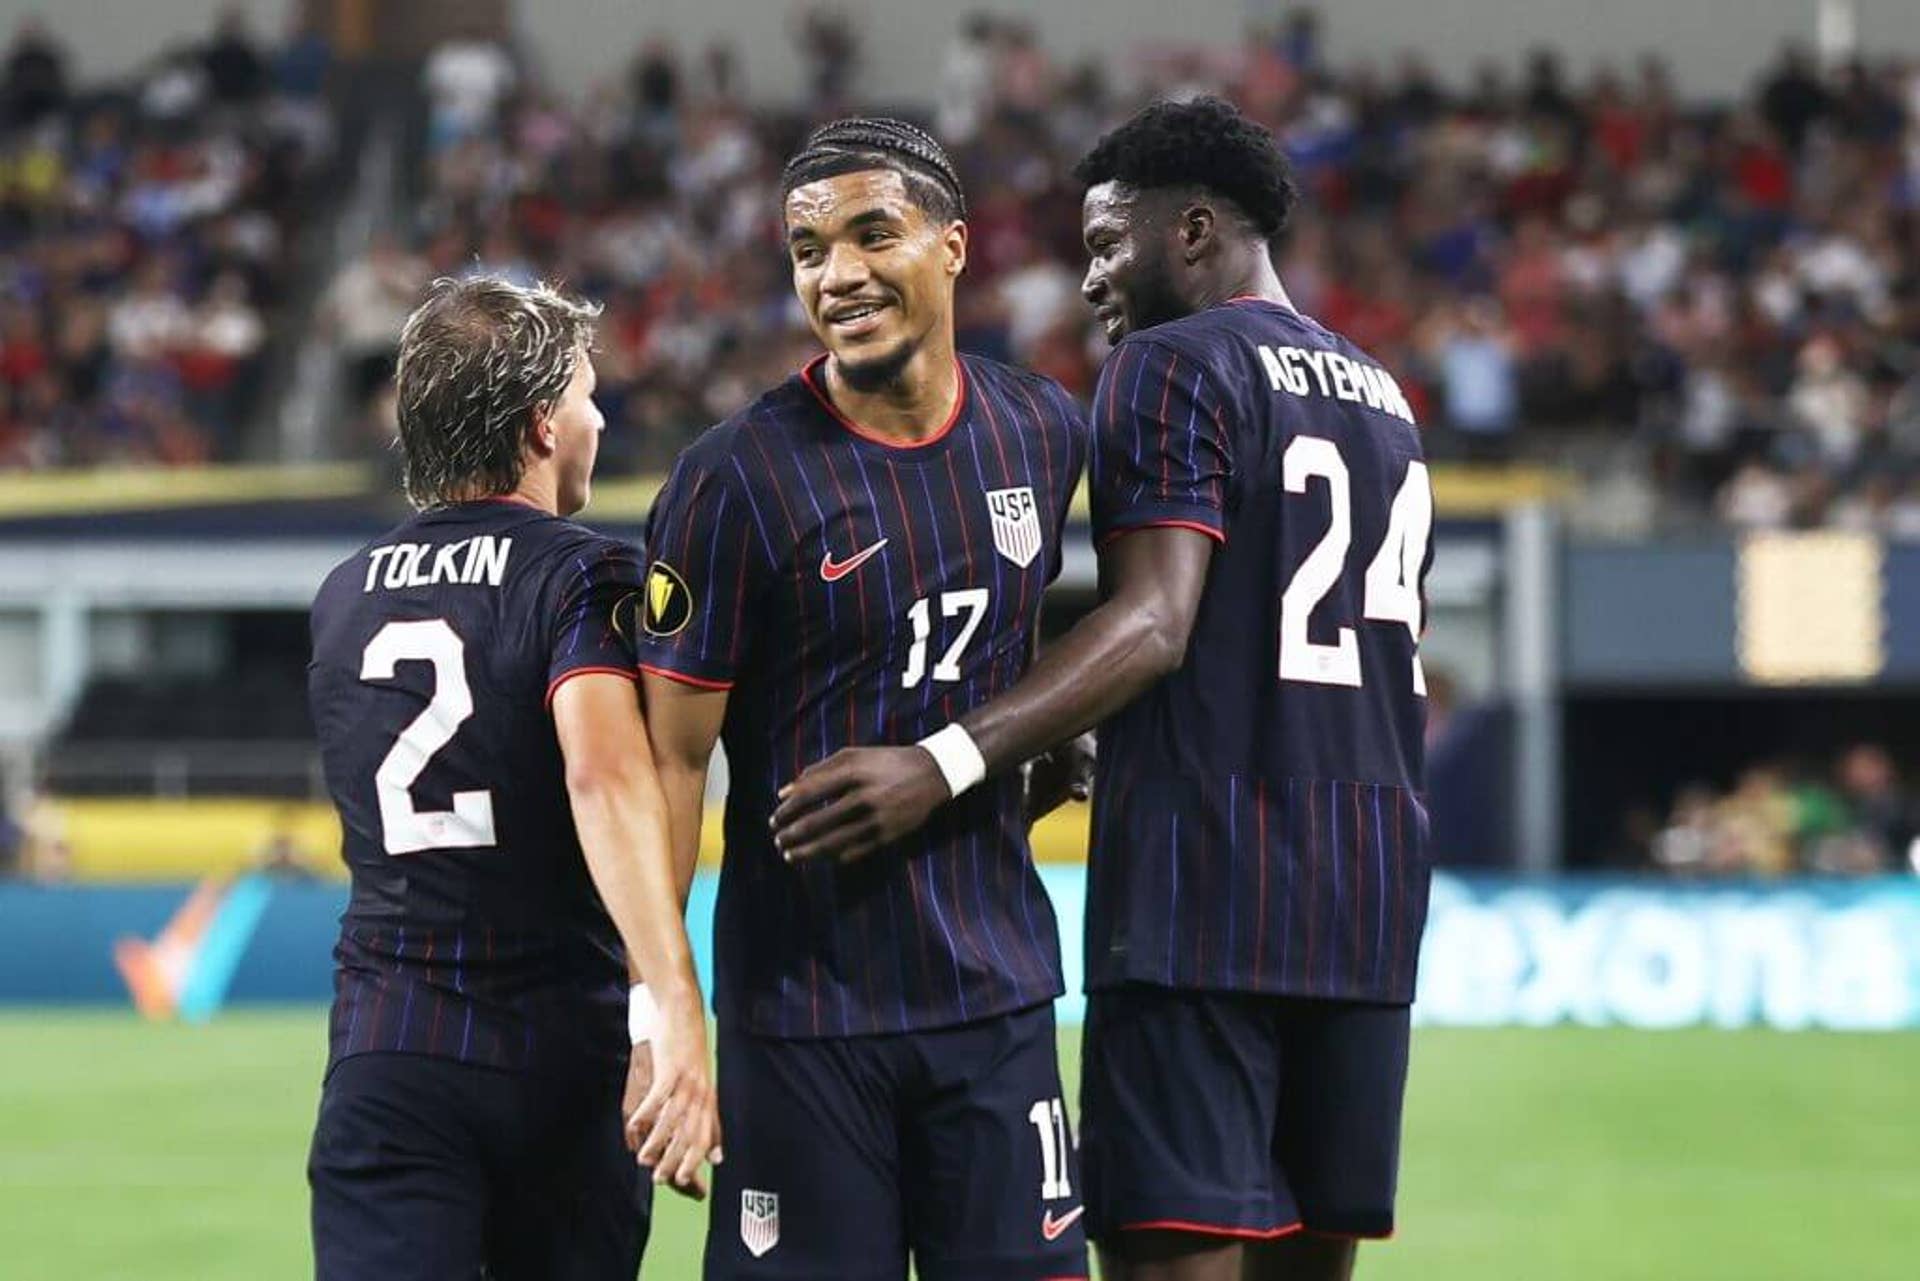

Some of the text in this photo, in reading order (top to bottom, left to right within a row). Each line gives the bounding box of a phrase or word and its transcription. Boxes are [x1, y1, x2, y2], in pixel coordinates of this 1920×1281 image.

[991, 491, 1033, 522] USA
[363, 535, 512, 592] TOLKIN
[1279, 434, 1433, 697] 24
[902, 588, 989, 689] 17
[359, 618, 498, 856] 2
[745, 1193, 776, 1219] USA
